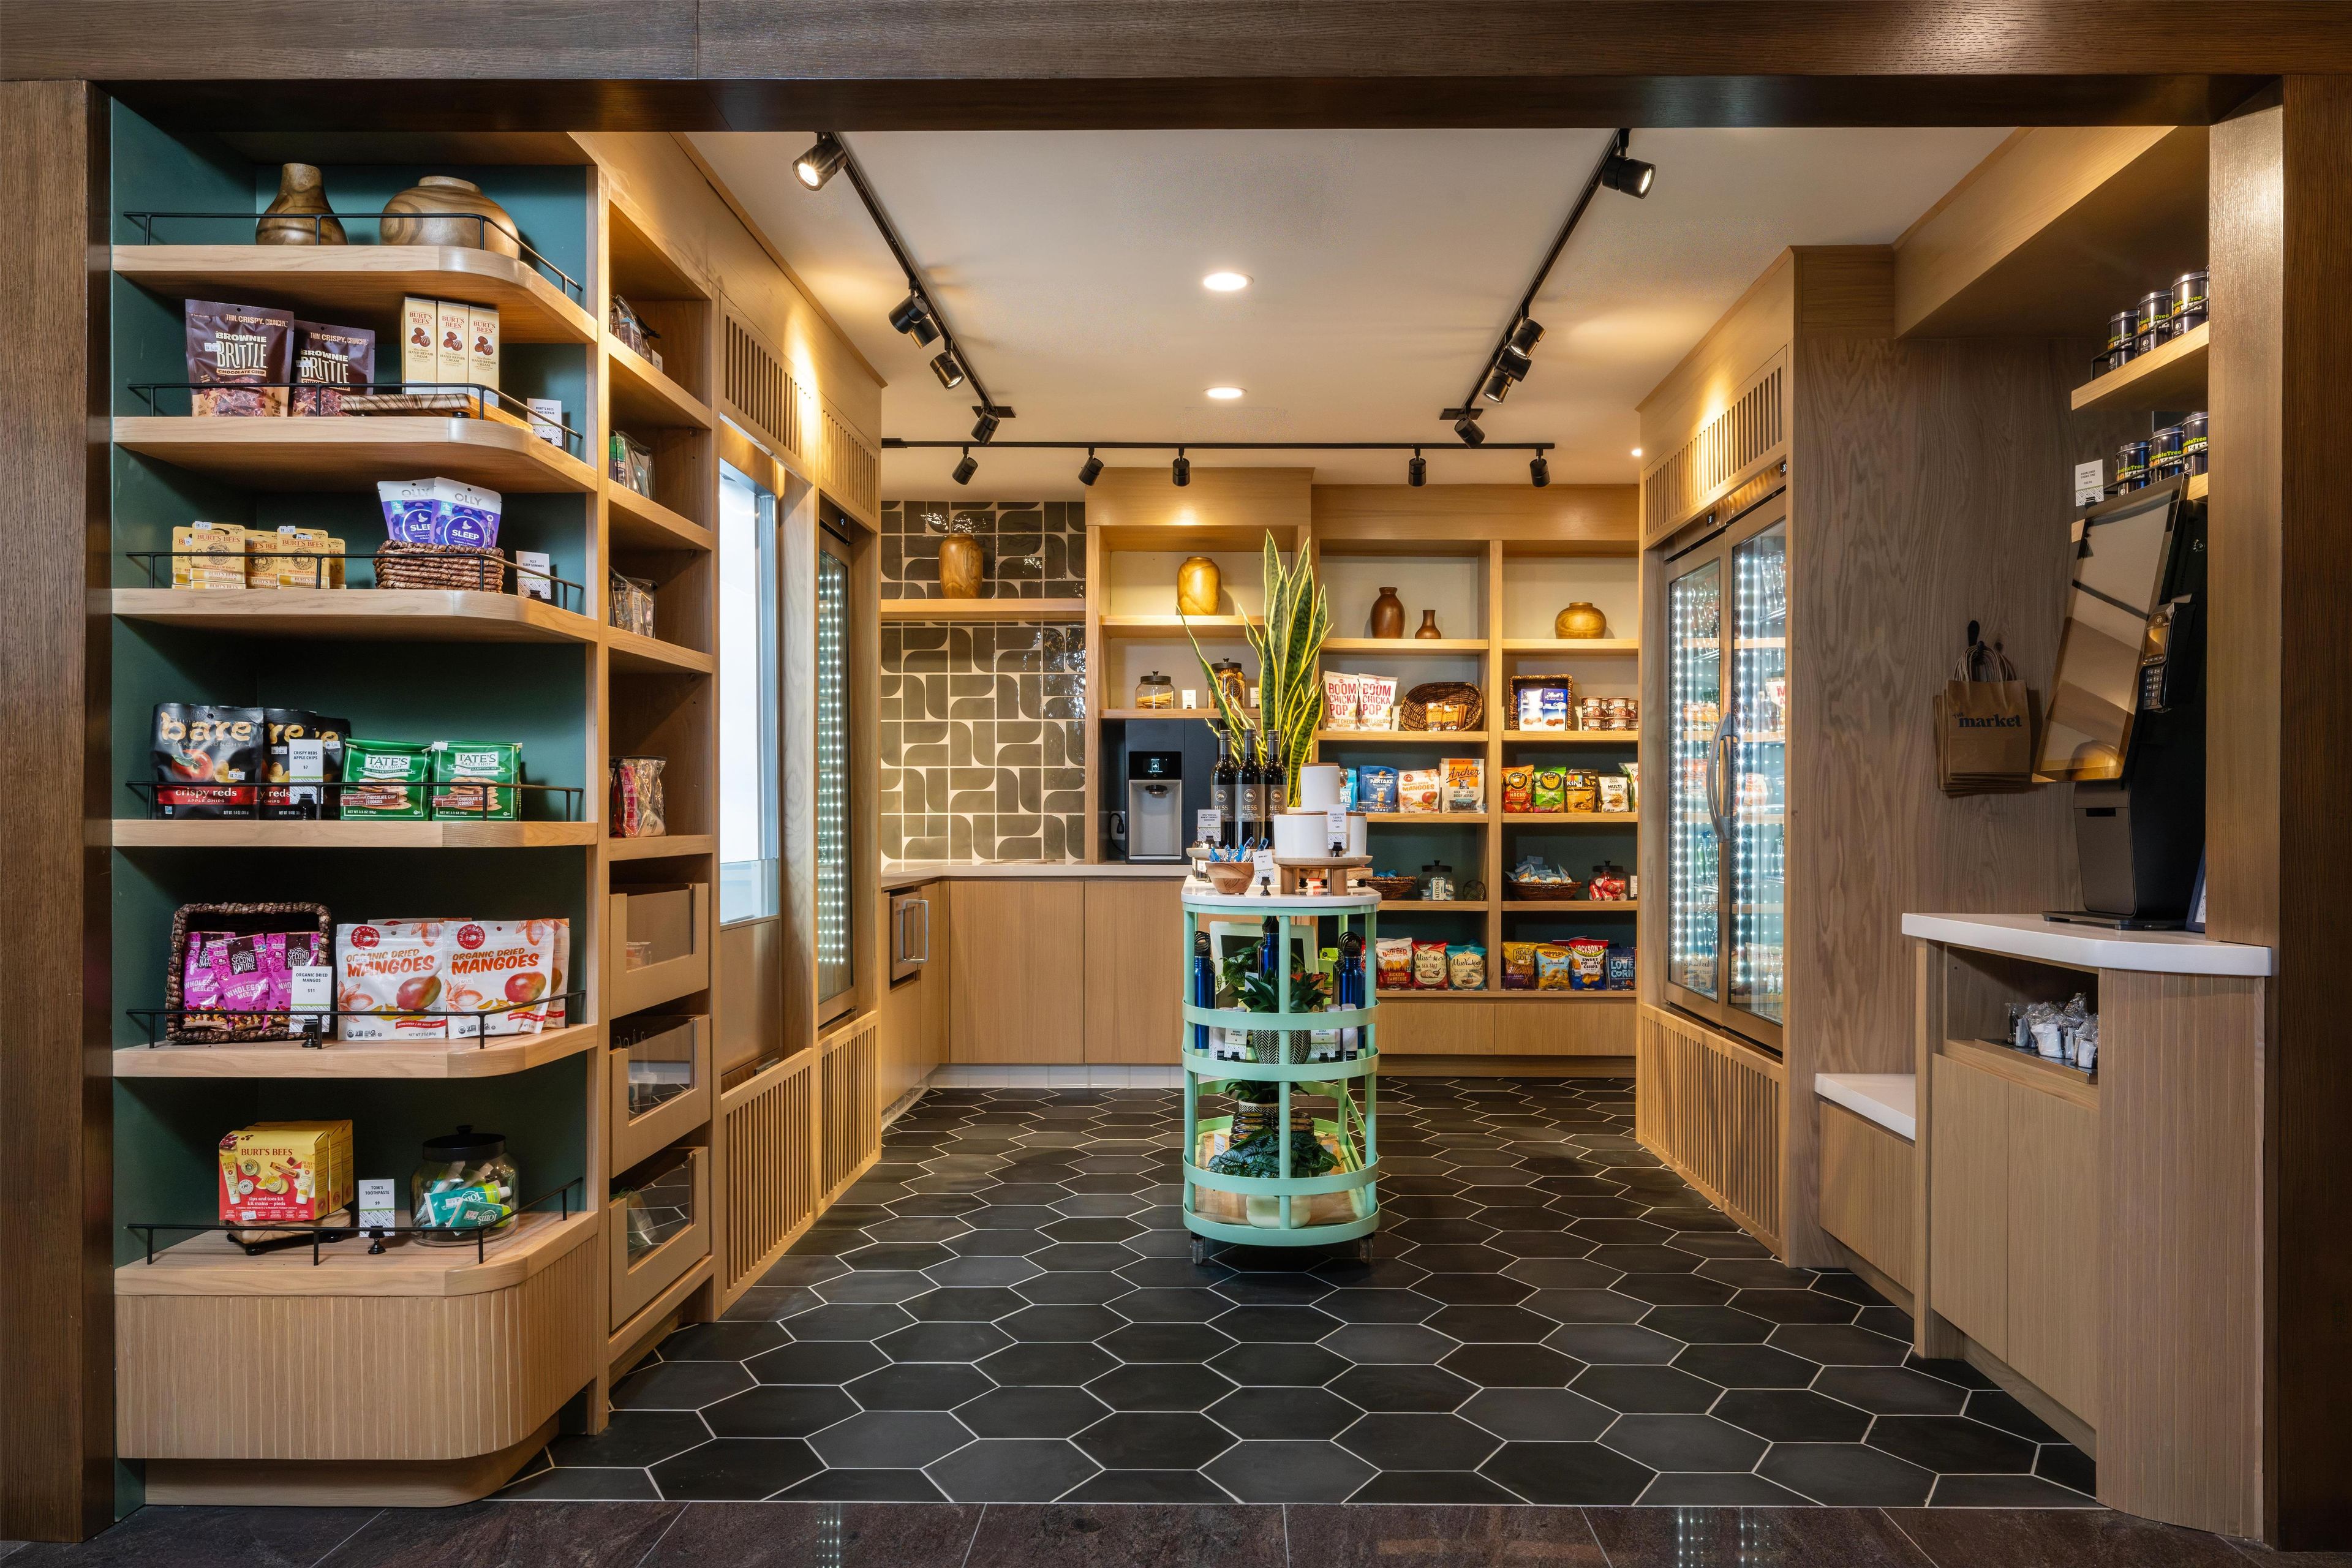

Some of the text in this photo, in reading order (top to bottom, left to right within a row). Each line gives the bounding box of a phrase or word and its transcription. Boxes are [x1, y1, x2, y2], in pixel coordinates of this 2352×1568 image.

[226, 314, 238, 322] THIN.
[238, 315, 265, 325] CRISPY.
[216, 331, 267, 342] BROWNIE
[322, 334, 347, 343] CRISPY.
[216, 341, 268, 369] BRITTLE
[301, 349, 349, 362] BROWNIE
[301, 356, 350, 384] BRITTLE
[401, 488, 430, 497] OLLY
[454, 492, 483, 506] OLLY
[451, 529, 480, 540] SLEEP
[1329, 683, 1357, 695] BOOM
[1363, 684, 1392, 696] BOOM
[1329, 695, 1357, 704] CHICKA
[1363, 695, 1391, 704] CHICKA
[1330, 704, 1348, 715] POP
[1363, 704, 1382, 715] POP
[160, 712, 252, 741] bare
[1959, 714, 2022, 728] market
[368, 756, 408, 766] TATE'S
[457, 754, 496, 763] TATE'S
[1446, 766, 1481, 780] Archer
[175, 787, 237, 799] crispy reds
[472, 926, 485, 941] NATURE
[287, 950, 309, 960] SECOND
[391, 949, 419, 958] DRIED
[452, 948, 525, 961] ORGANIC DRIED
[1575, 945, 1603, 954] JACKSON'S
[232, 953, 255, 965] SECOND
[451, 953, 540, 975] MANGOES
[233, 962, 255, 974] NATURE
[347, 955, 435, 978] MANGOES
[1610, 960, 1634, 970] LOVE
[1611, 970, 1634, 978] CORN
